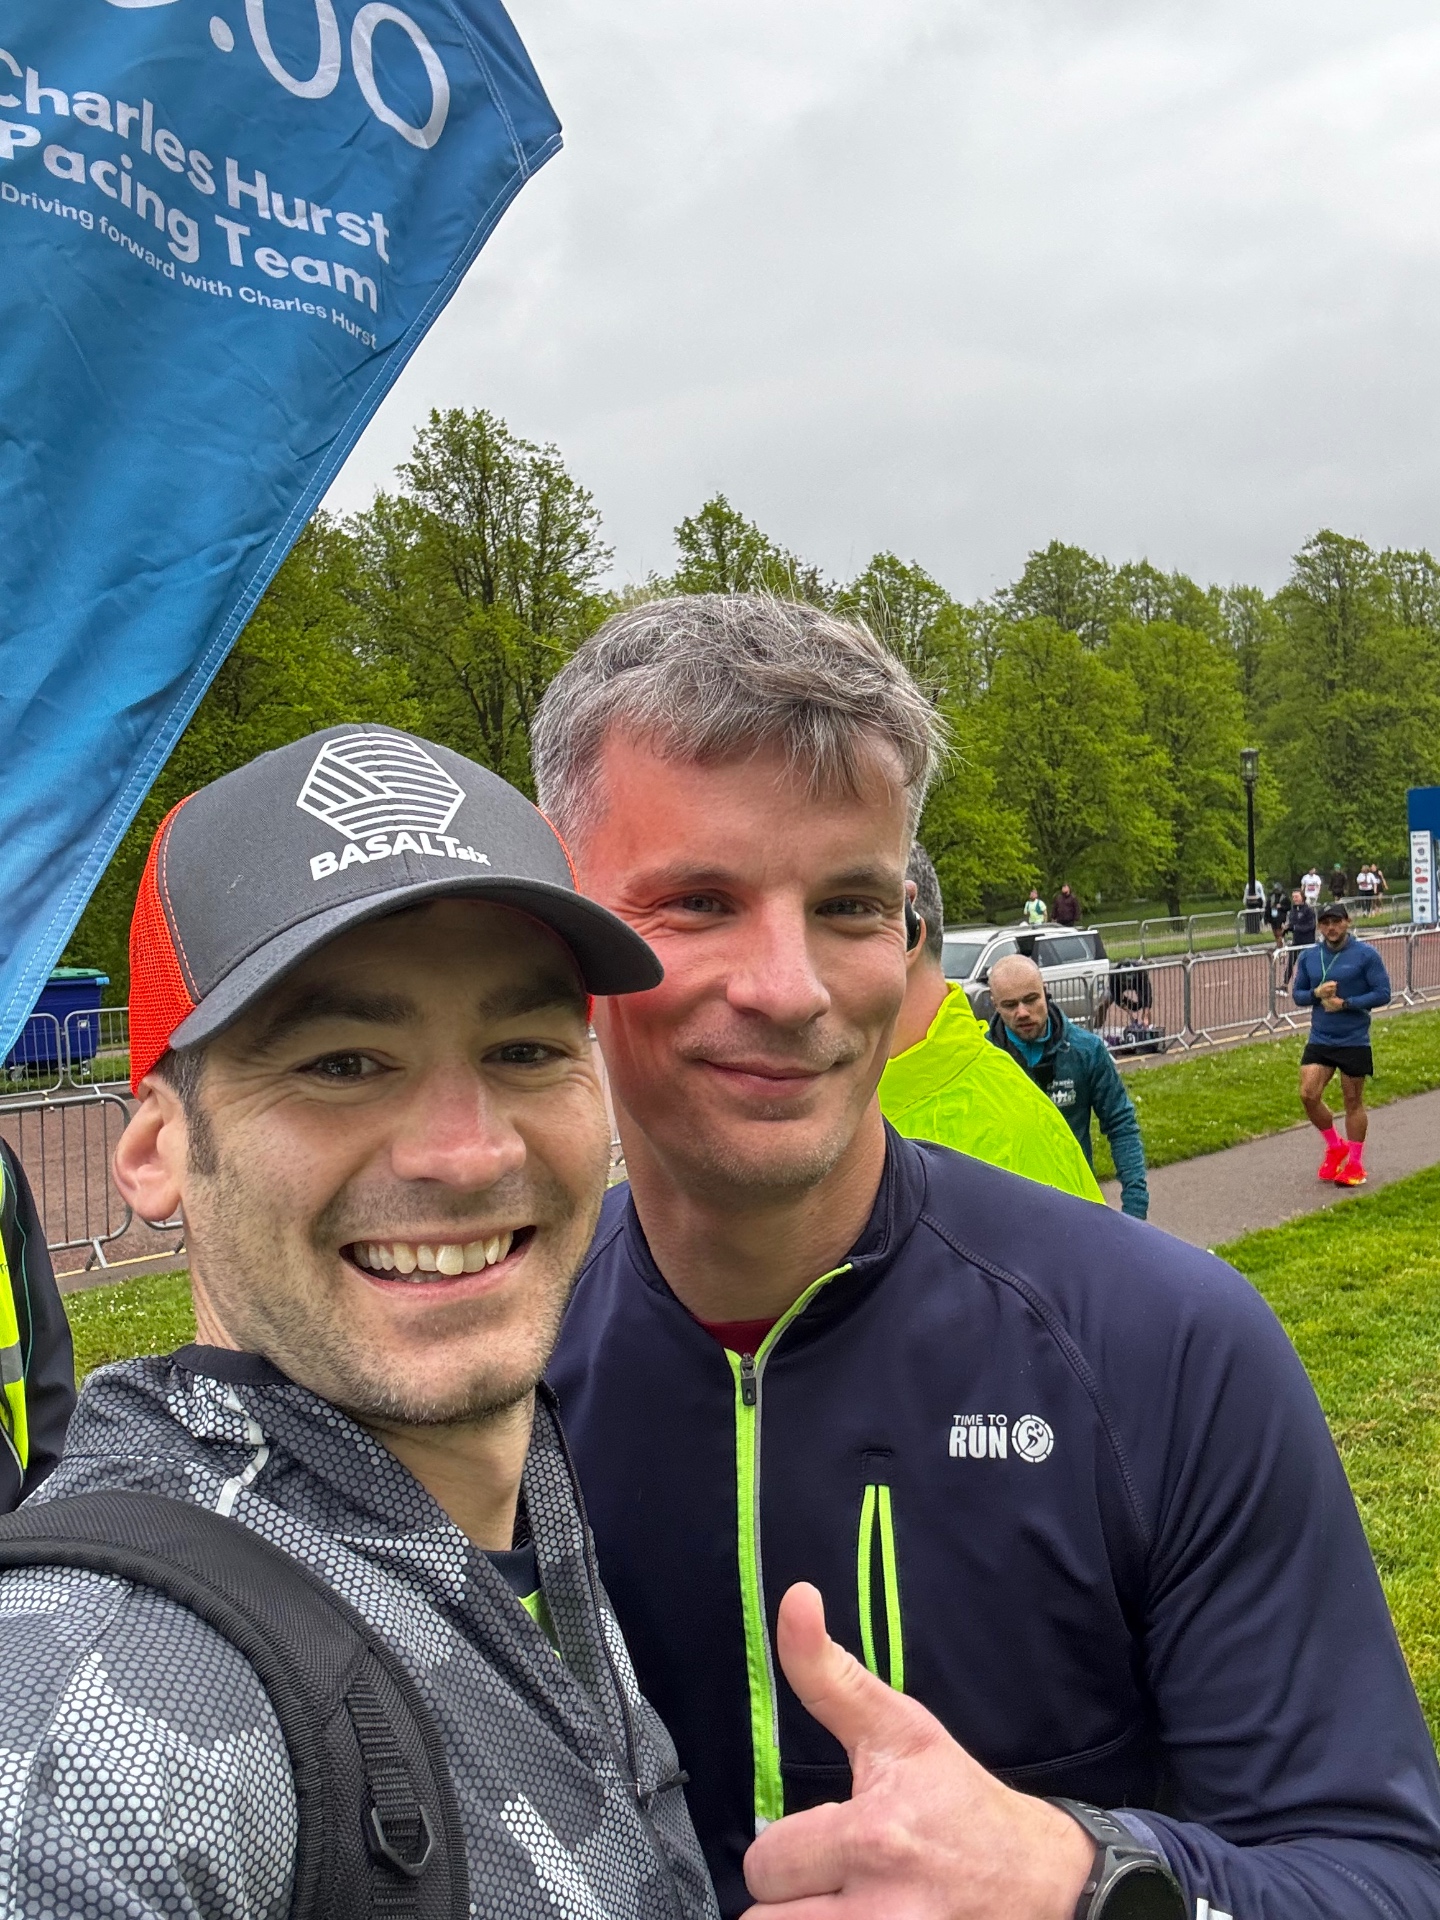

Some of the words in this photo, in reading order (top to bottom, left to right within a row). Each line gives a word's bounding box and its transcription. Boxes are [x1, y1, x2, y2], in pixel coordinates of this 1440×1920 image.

[0, 120, 199, 263] Pacing
[215, 215, 378, 313] Team
[227, 158, 390, 263] Hurst
[1, 181, 94, 230] Driving
[99, 216, 176, 280] forward
[181, 271, 233, 298] with
[239, 286, 327, 319] Charles
[331, 308, 377, 350] Hurst
[949, 1426, 1008, 1459] RUN
[953, 1414, 983, 1426] TIME
[987, 1414, 1008, 1426] TO
